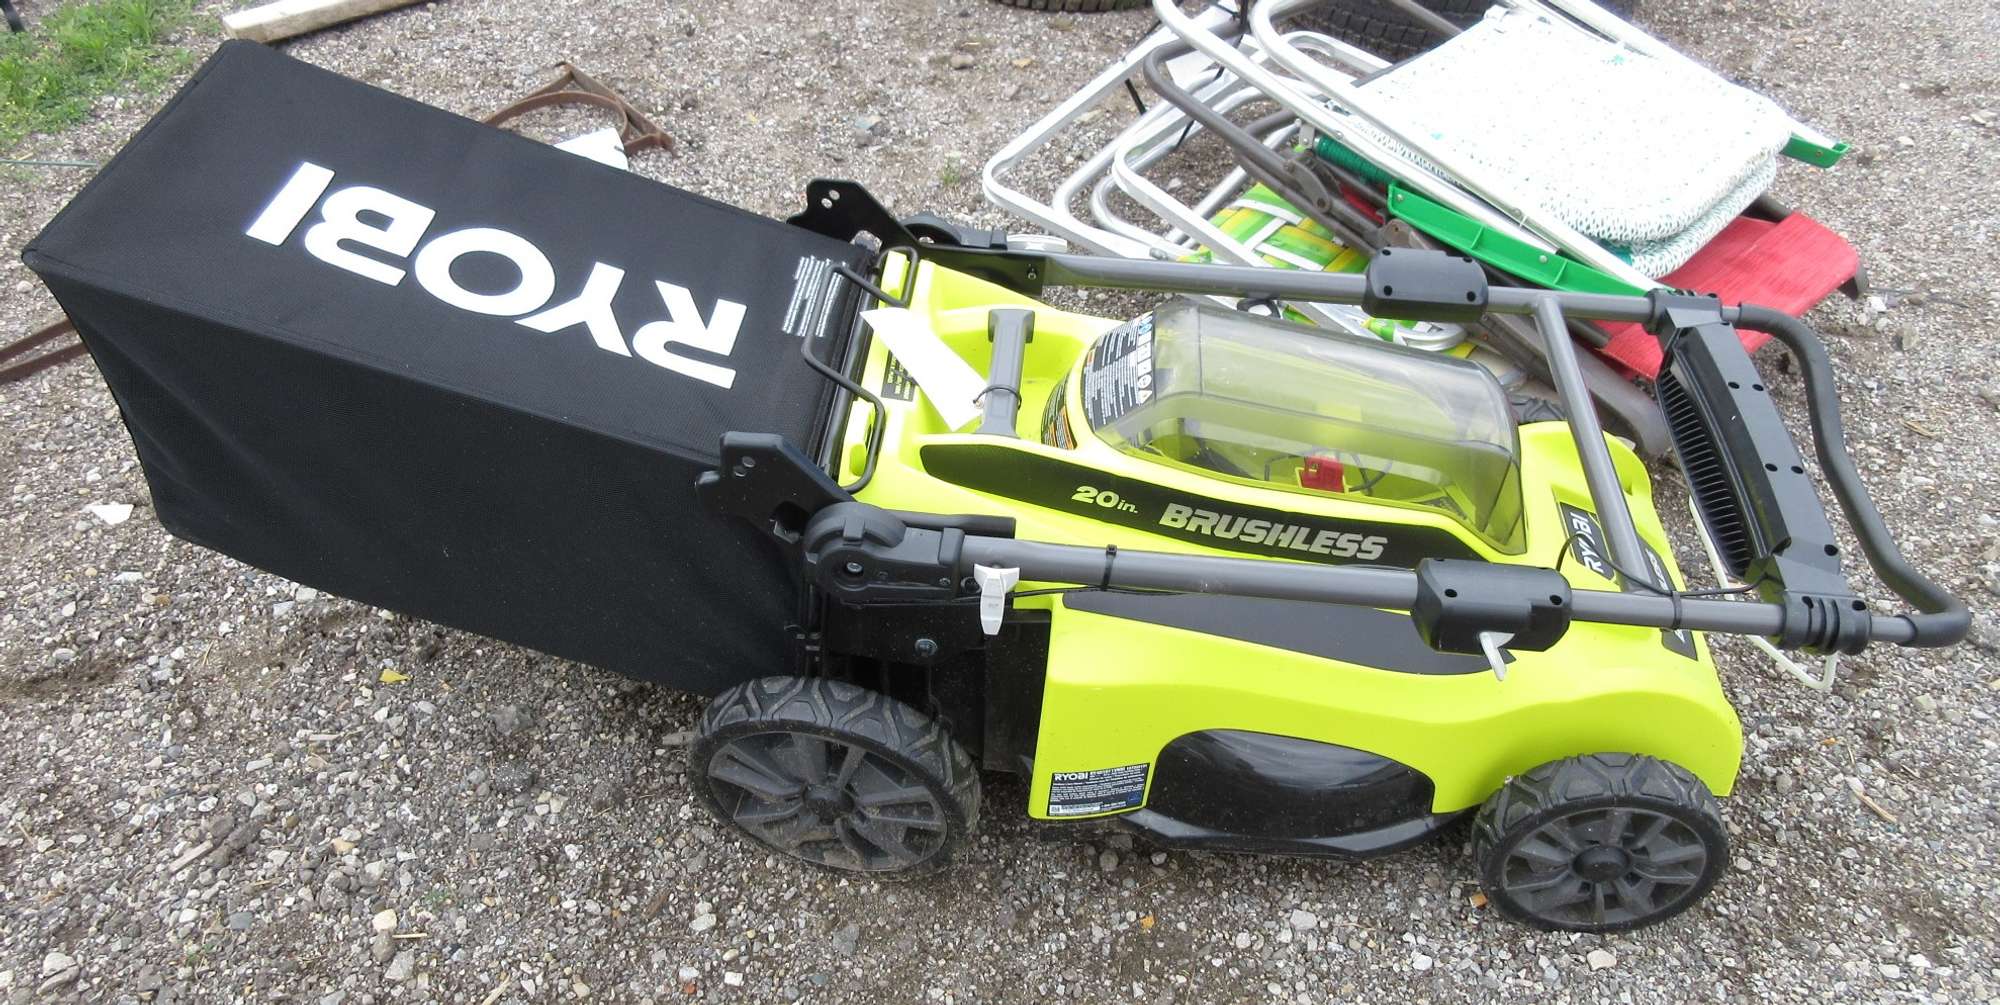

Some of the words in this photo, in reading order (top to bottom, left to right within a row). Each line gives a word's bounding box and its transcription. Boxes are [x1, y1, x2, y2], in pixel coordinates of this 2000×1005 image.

[245, 161, 748, 390] RYOBI
[1158, 502, 1389, 560] BRUSHLESS
[1054, 772, 1089, 781] RYOBI
